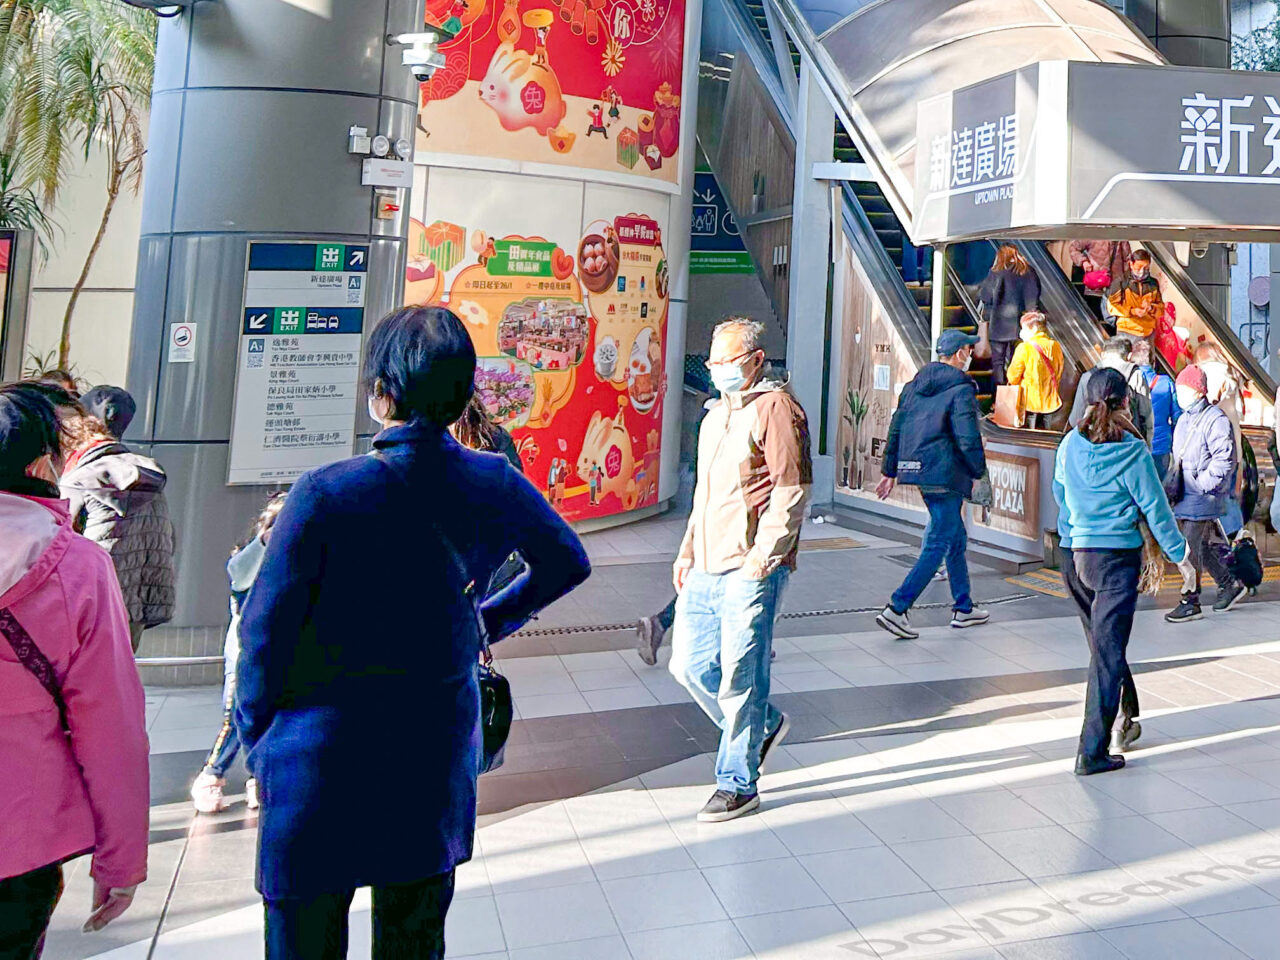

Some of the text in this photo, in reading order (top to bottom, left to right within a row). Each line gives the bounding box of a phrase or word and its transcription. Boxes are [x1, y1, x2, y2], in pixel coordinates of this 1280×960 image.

[929, 114, 1019, 191] 新達廣場
[974, 185, 1018, 205] UPTOWN PLAZ
[322, 247, 340, 262] 出
[280, 310, 299, 325] 出
[994, 487, 1025, 515] PLAZA
